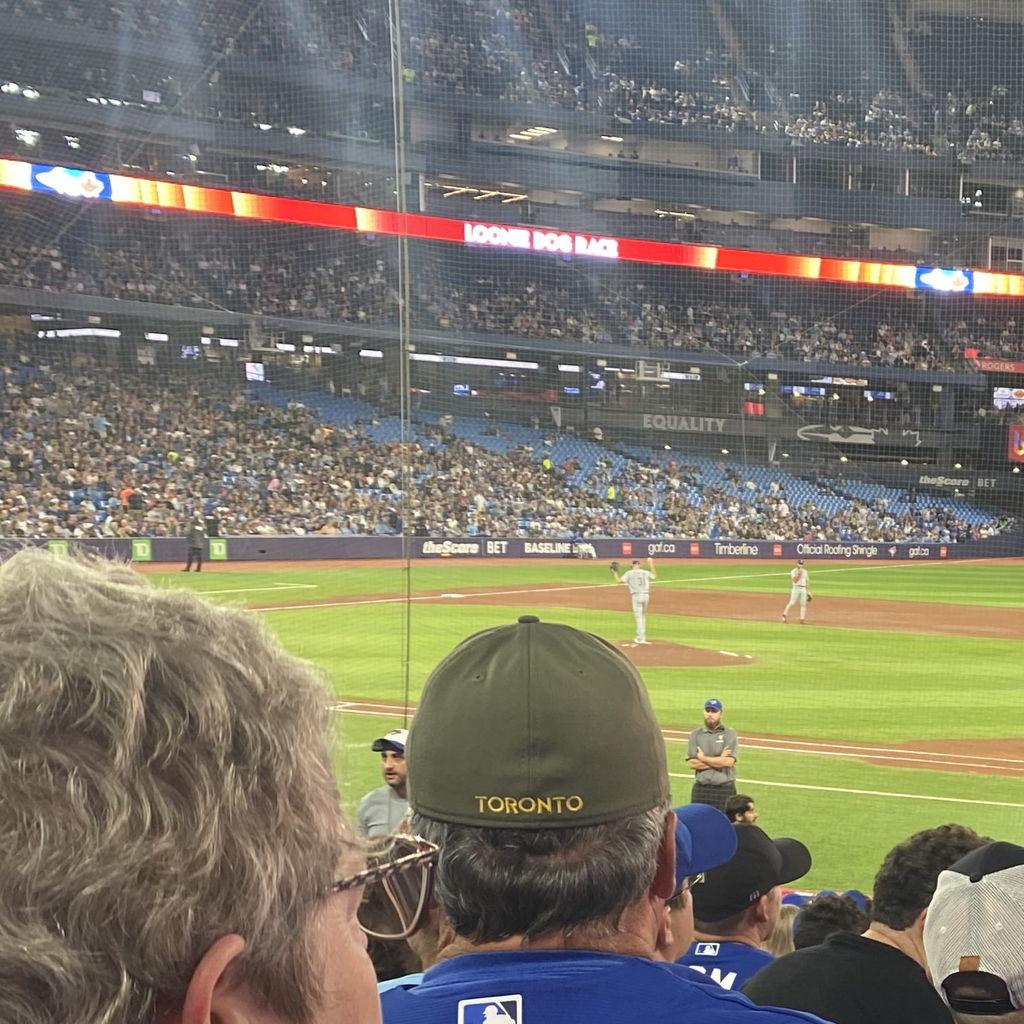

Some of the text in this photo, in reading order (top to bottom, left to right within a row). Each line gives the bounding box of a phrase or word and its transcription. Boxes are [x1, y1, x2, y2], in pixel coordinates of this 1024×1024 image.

[981, 361, 1015, 372] ROGERS
[643, 414, 725, 433] EQUALITY
[919, 475, 997, 488] theScore BET
[422, 541, 508, 555] theScore BET
[524, 542, 571, 554] BASELINE
[648, 542, 675, 556] gaf.ca
[714, 542, 759, 556] Timberline
[797, 543, 823, 555] Official
[824, 544, 851, 558] Roofing
[852, 544, 878, 558] Shingle
[475, 795, 584, 814] TORONTO
